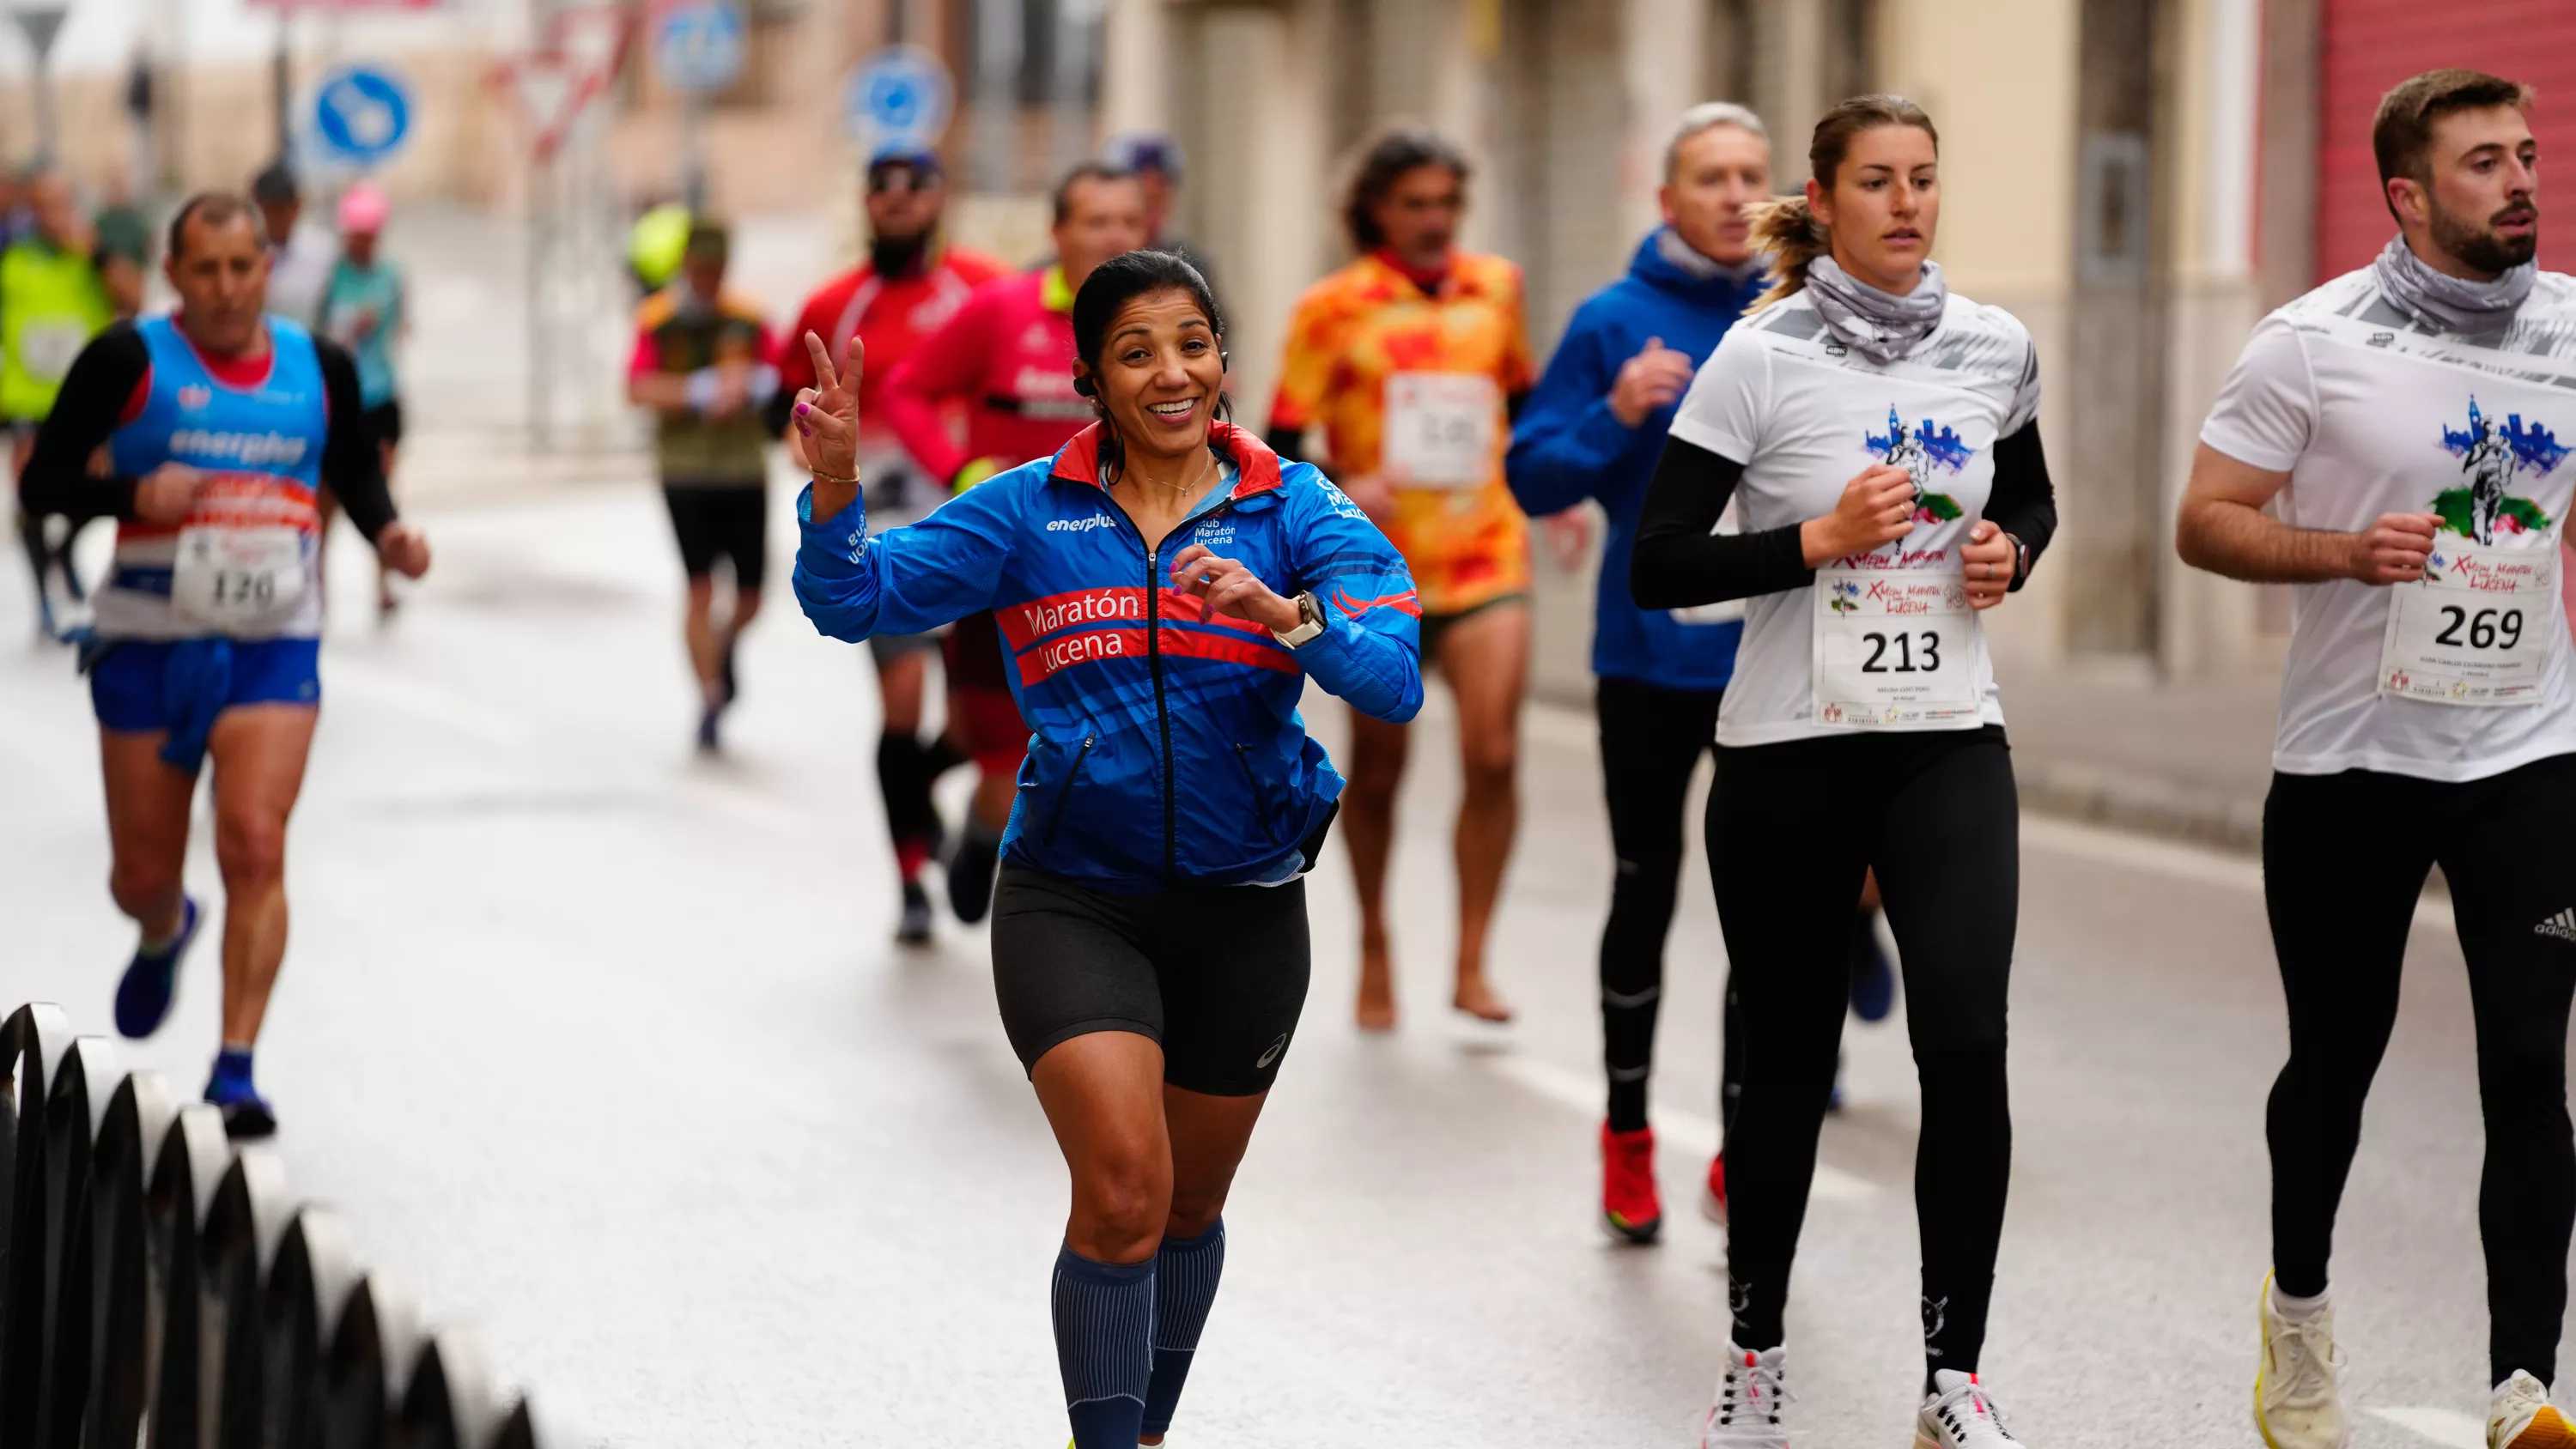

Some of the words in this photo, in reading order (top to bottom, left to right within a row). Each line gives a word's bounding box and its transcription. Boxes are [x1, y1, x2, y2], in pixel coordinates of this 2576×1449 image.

[1194, 526, 1236, 537] Maratón
[1194, 537, 1233, 545] Lucena
[2470, 574, 2518, 593] LUCENA
[1024, 589, 1139, 636] Maratón
[1886, 600, 1929, 615] LUCENA
[2435, 603, 2524, 650] 269
[1862, 630, 1941, 672] 213
[2534, 924, 2576, 943] adida
